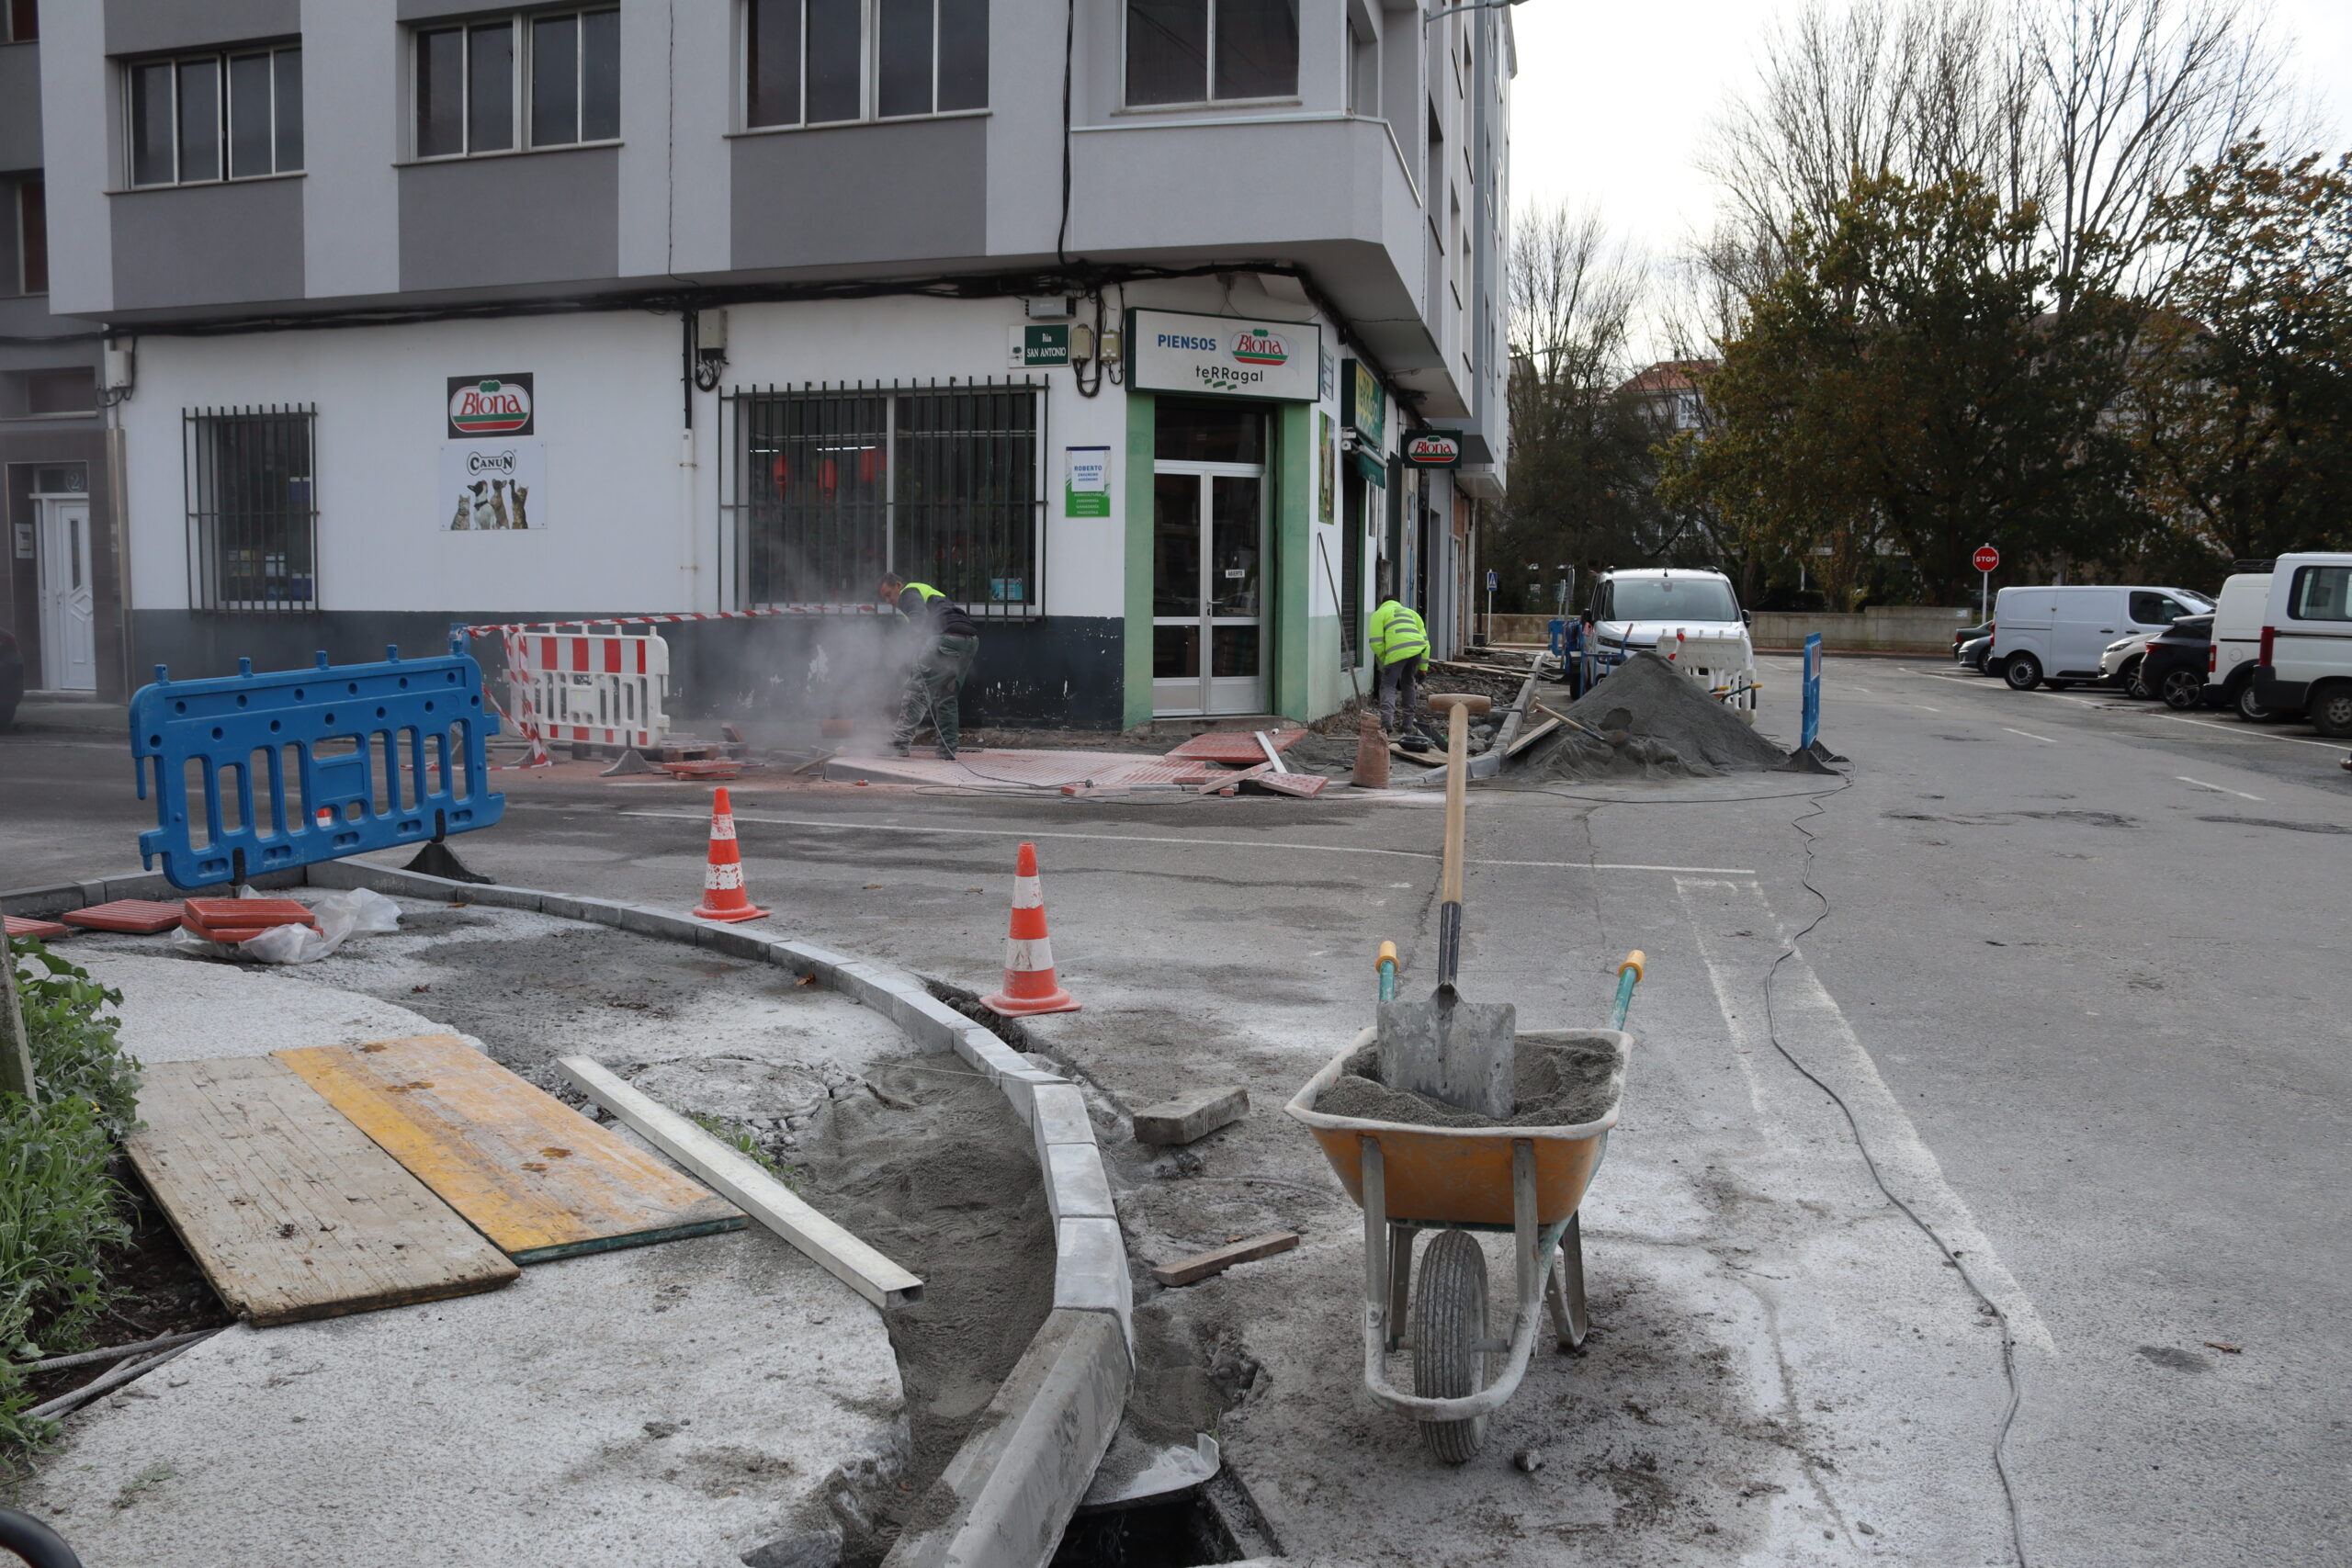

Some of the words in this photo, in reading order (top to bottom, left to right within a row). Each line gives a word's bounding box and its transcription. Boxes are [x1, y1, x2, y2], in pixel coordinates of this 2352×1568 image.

[1158, 333, 1216, 352] PIENSOS
[1026, 348, 1039, 358] SAN
[1040, 347, 1067, 357] ANTONIO
